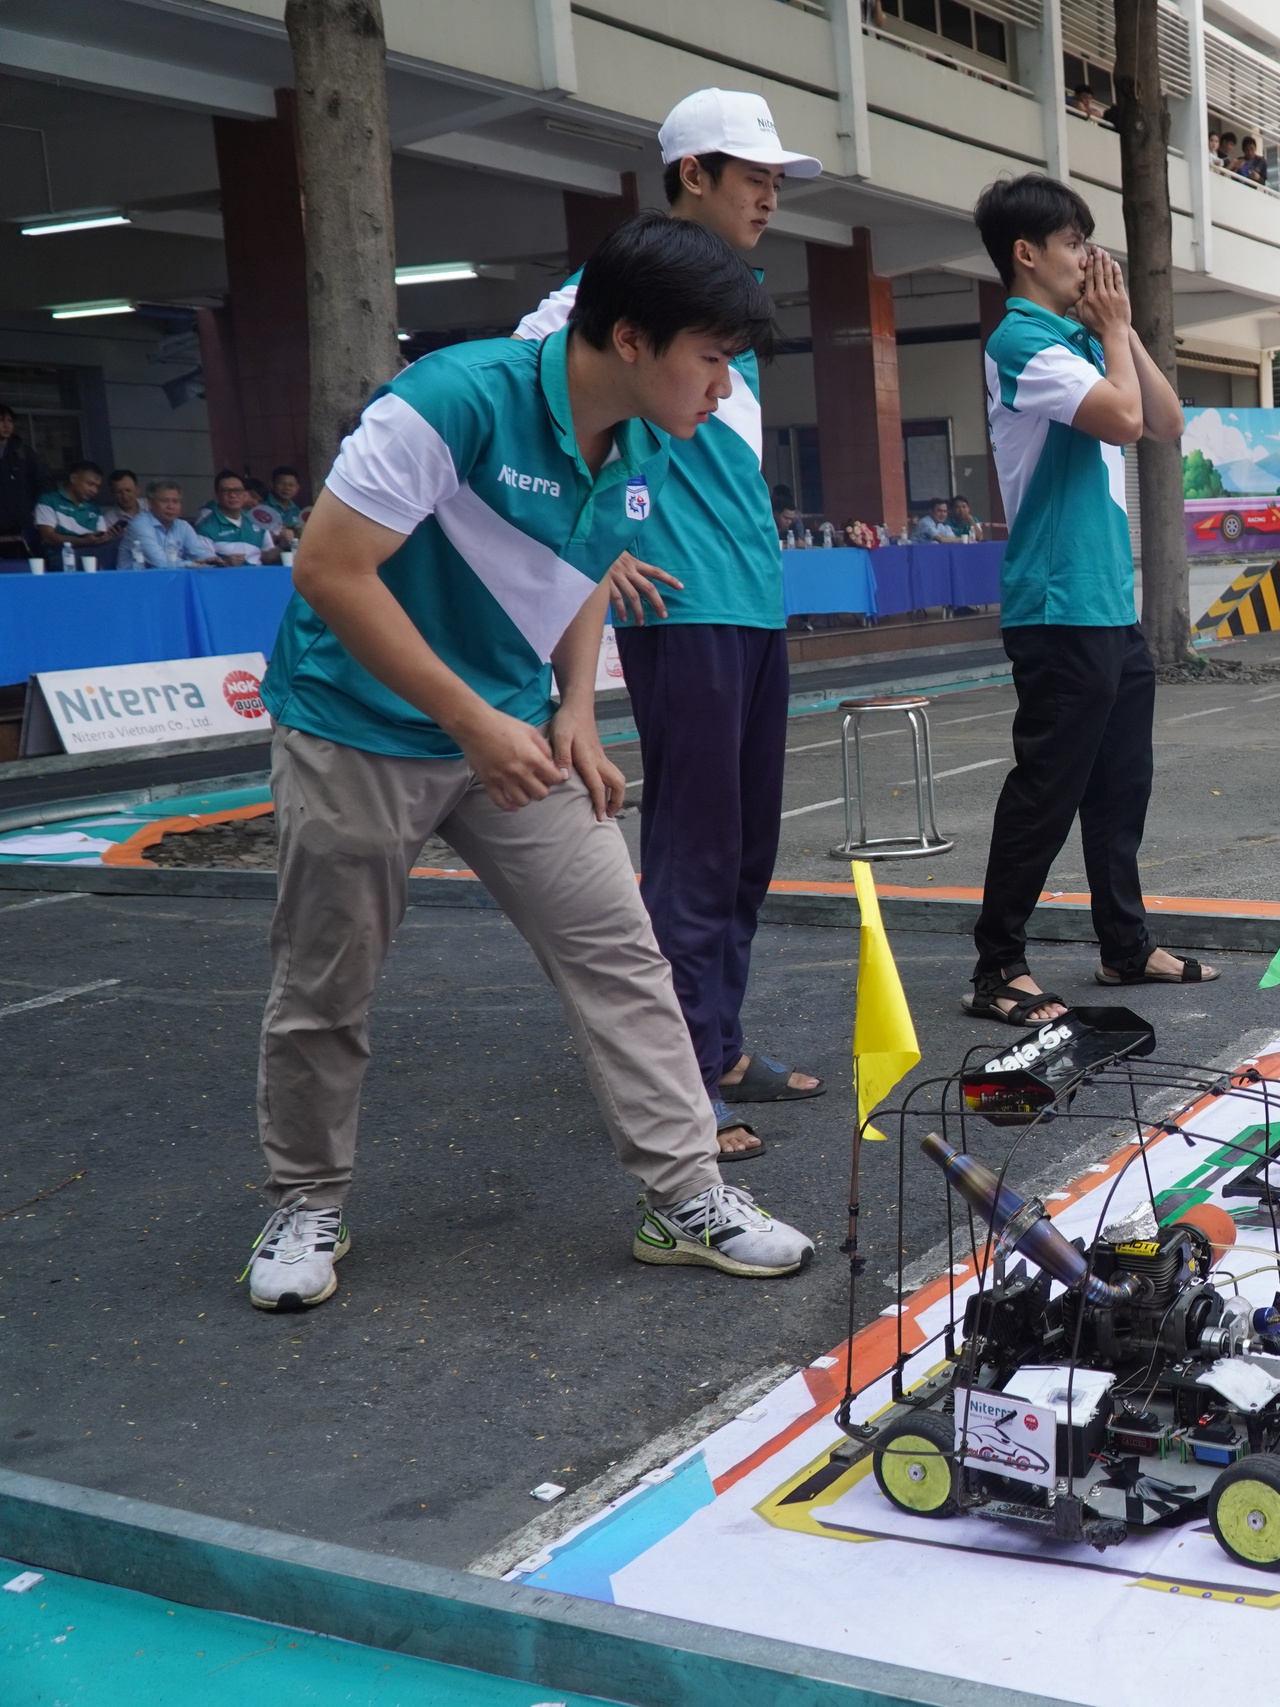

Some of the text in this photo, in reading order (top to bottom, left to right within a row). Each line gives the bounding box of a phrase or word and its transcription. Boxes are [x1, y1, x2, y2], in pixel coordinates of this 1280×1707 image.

[497, 463, 561, 498] Niterra
[226, 680, 258, 694] NGK
[54, 682, 206, 724] Niterra
[235, 698, 263, 711] BUGI
[71, 729, 115, 744] Niterra
[115, 722, 166, 738] Vietnam
